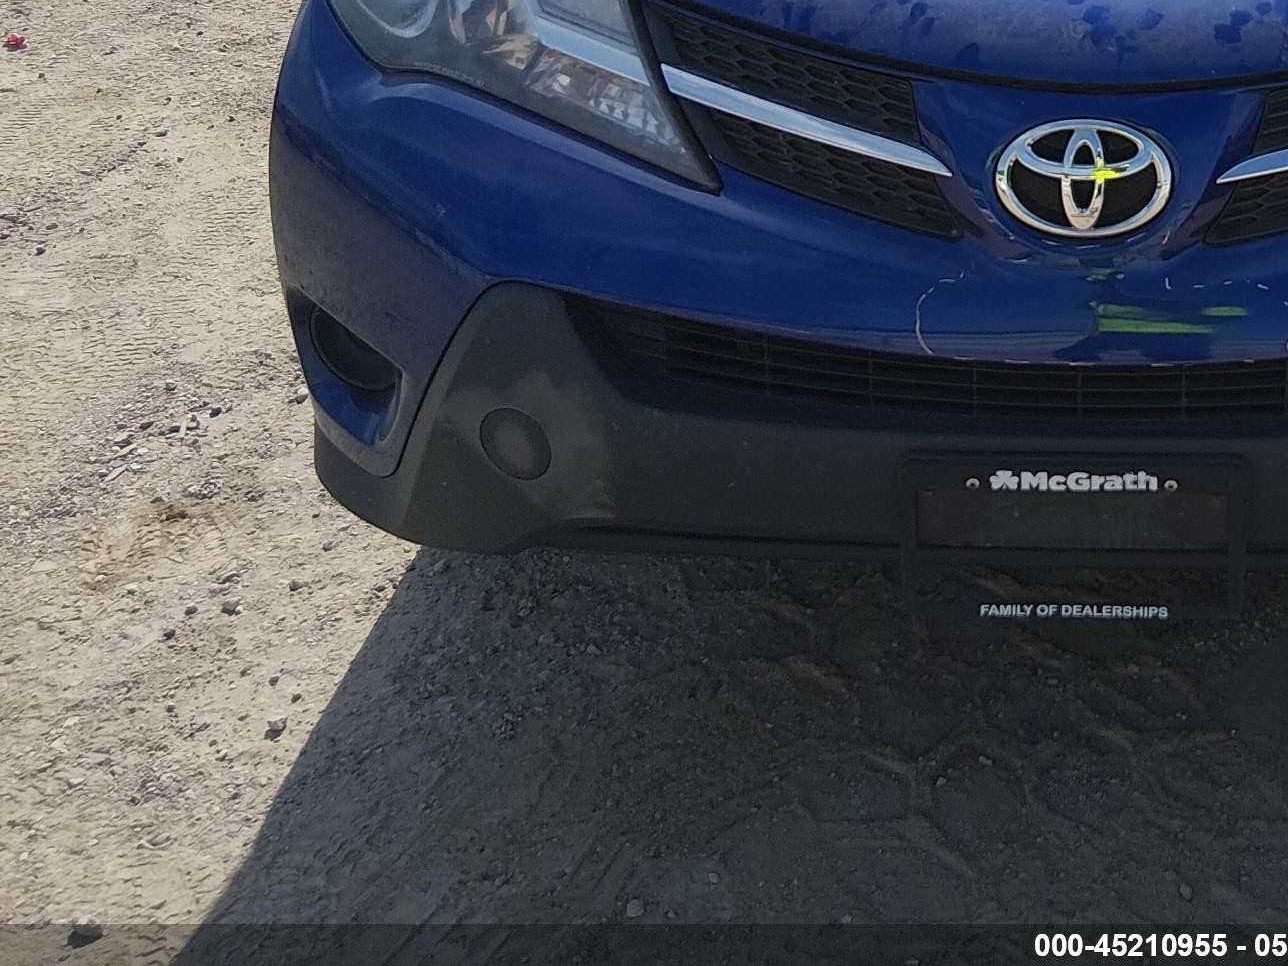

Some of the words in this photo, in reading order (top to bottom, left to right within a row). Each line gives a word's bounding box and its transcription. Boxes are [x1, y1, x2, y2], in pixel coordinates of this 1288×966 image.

[1020, 470, 1158, 491] McGrath
[980, 604, 1034, 617] FAMILY
[1036, 604, 1058, 617] OF
[1061, 604, 1169, 619] DEALERSHIPS
